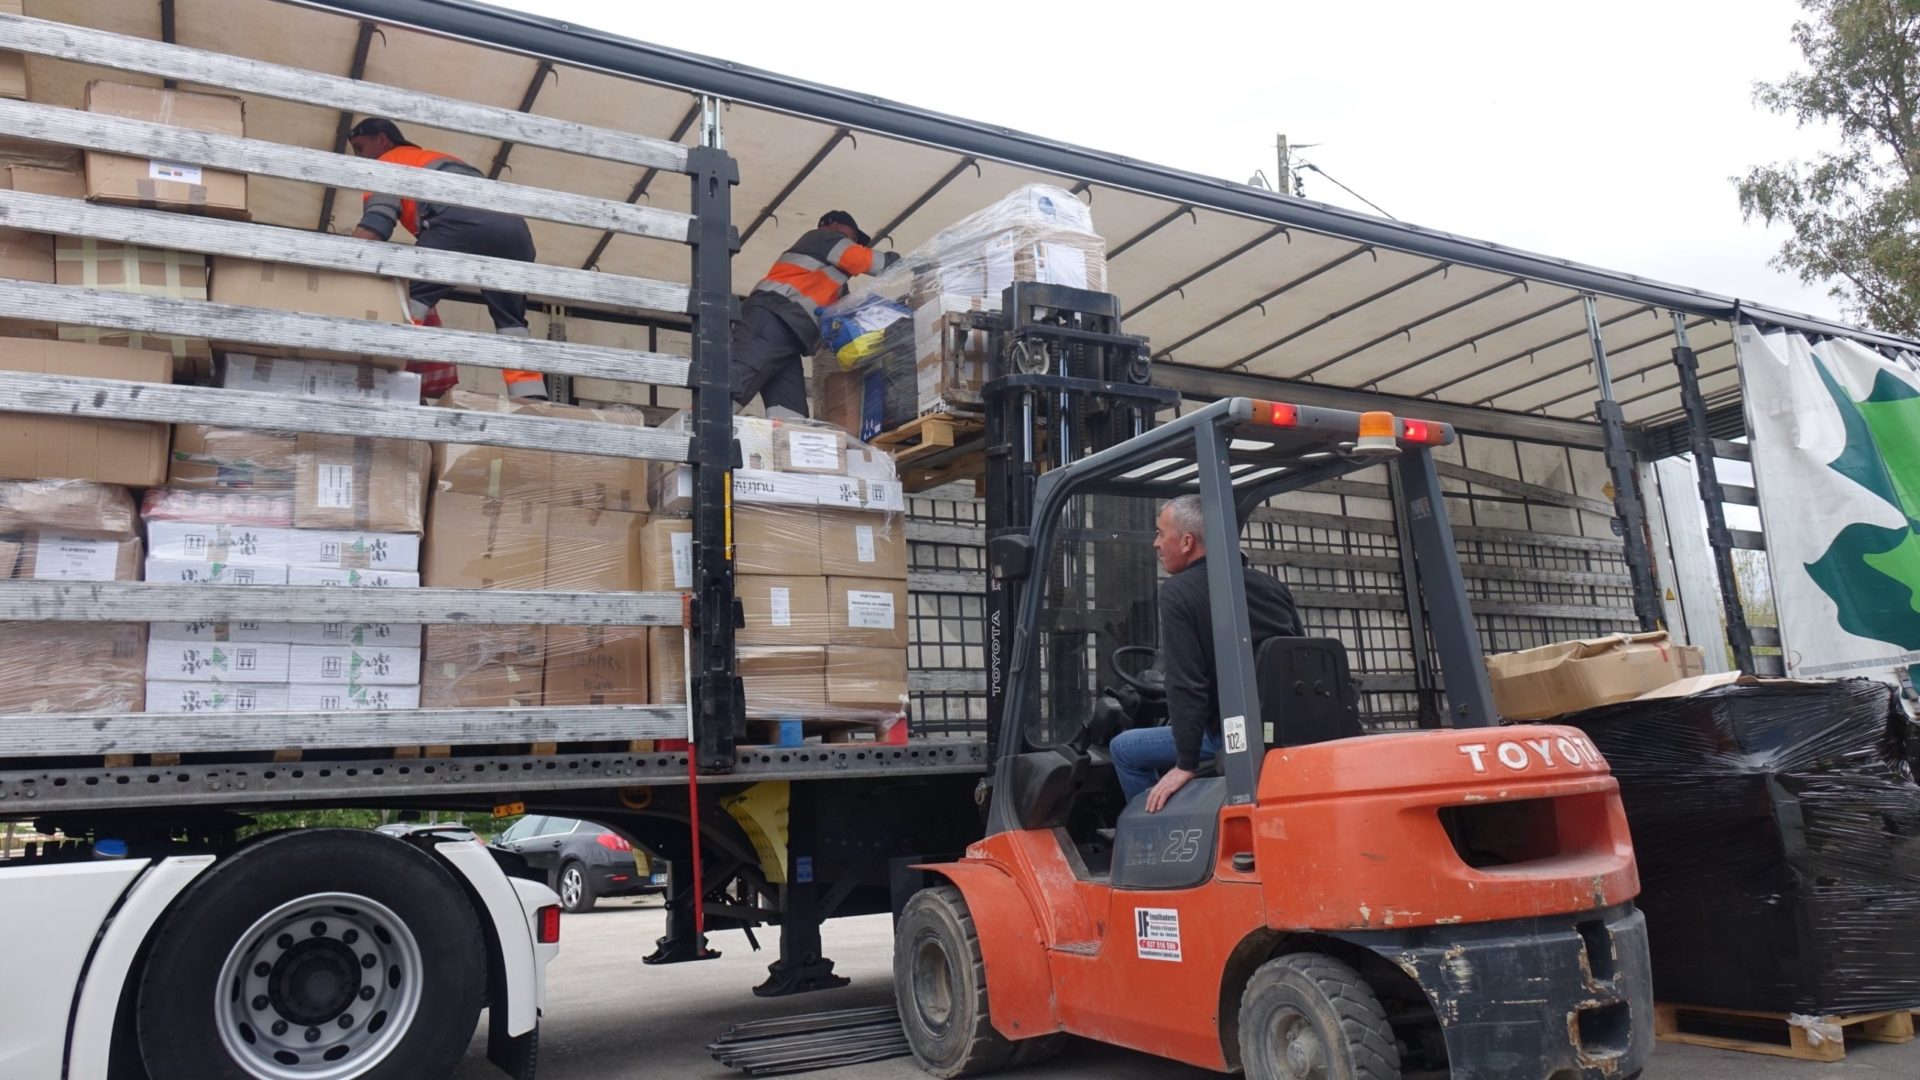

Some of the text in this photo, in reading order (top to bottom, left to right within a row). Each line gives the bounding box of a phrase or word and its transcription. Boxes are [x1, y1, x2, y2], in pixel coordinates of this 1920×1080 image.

[60, 546, 96, 554] ALIMENTOS
[991, 609, 1001, 697] TOYOTA
[1226, 732, 1241, 751] 102
[1161, 828, 1203, 863] 25
[1138, 910, 1150, 938] JF
